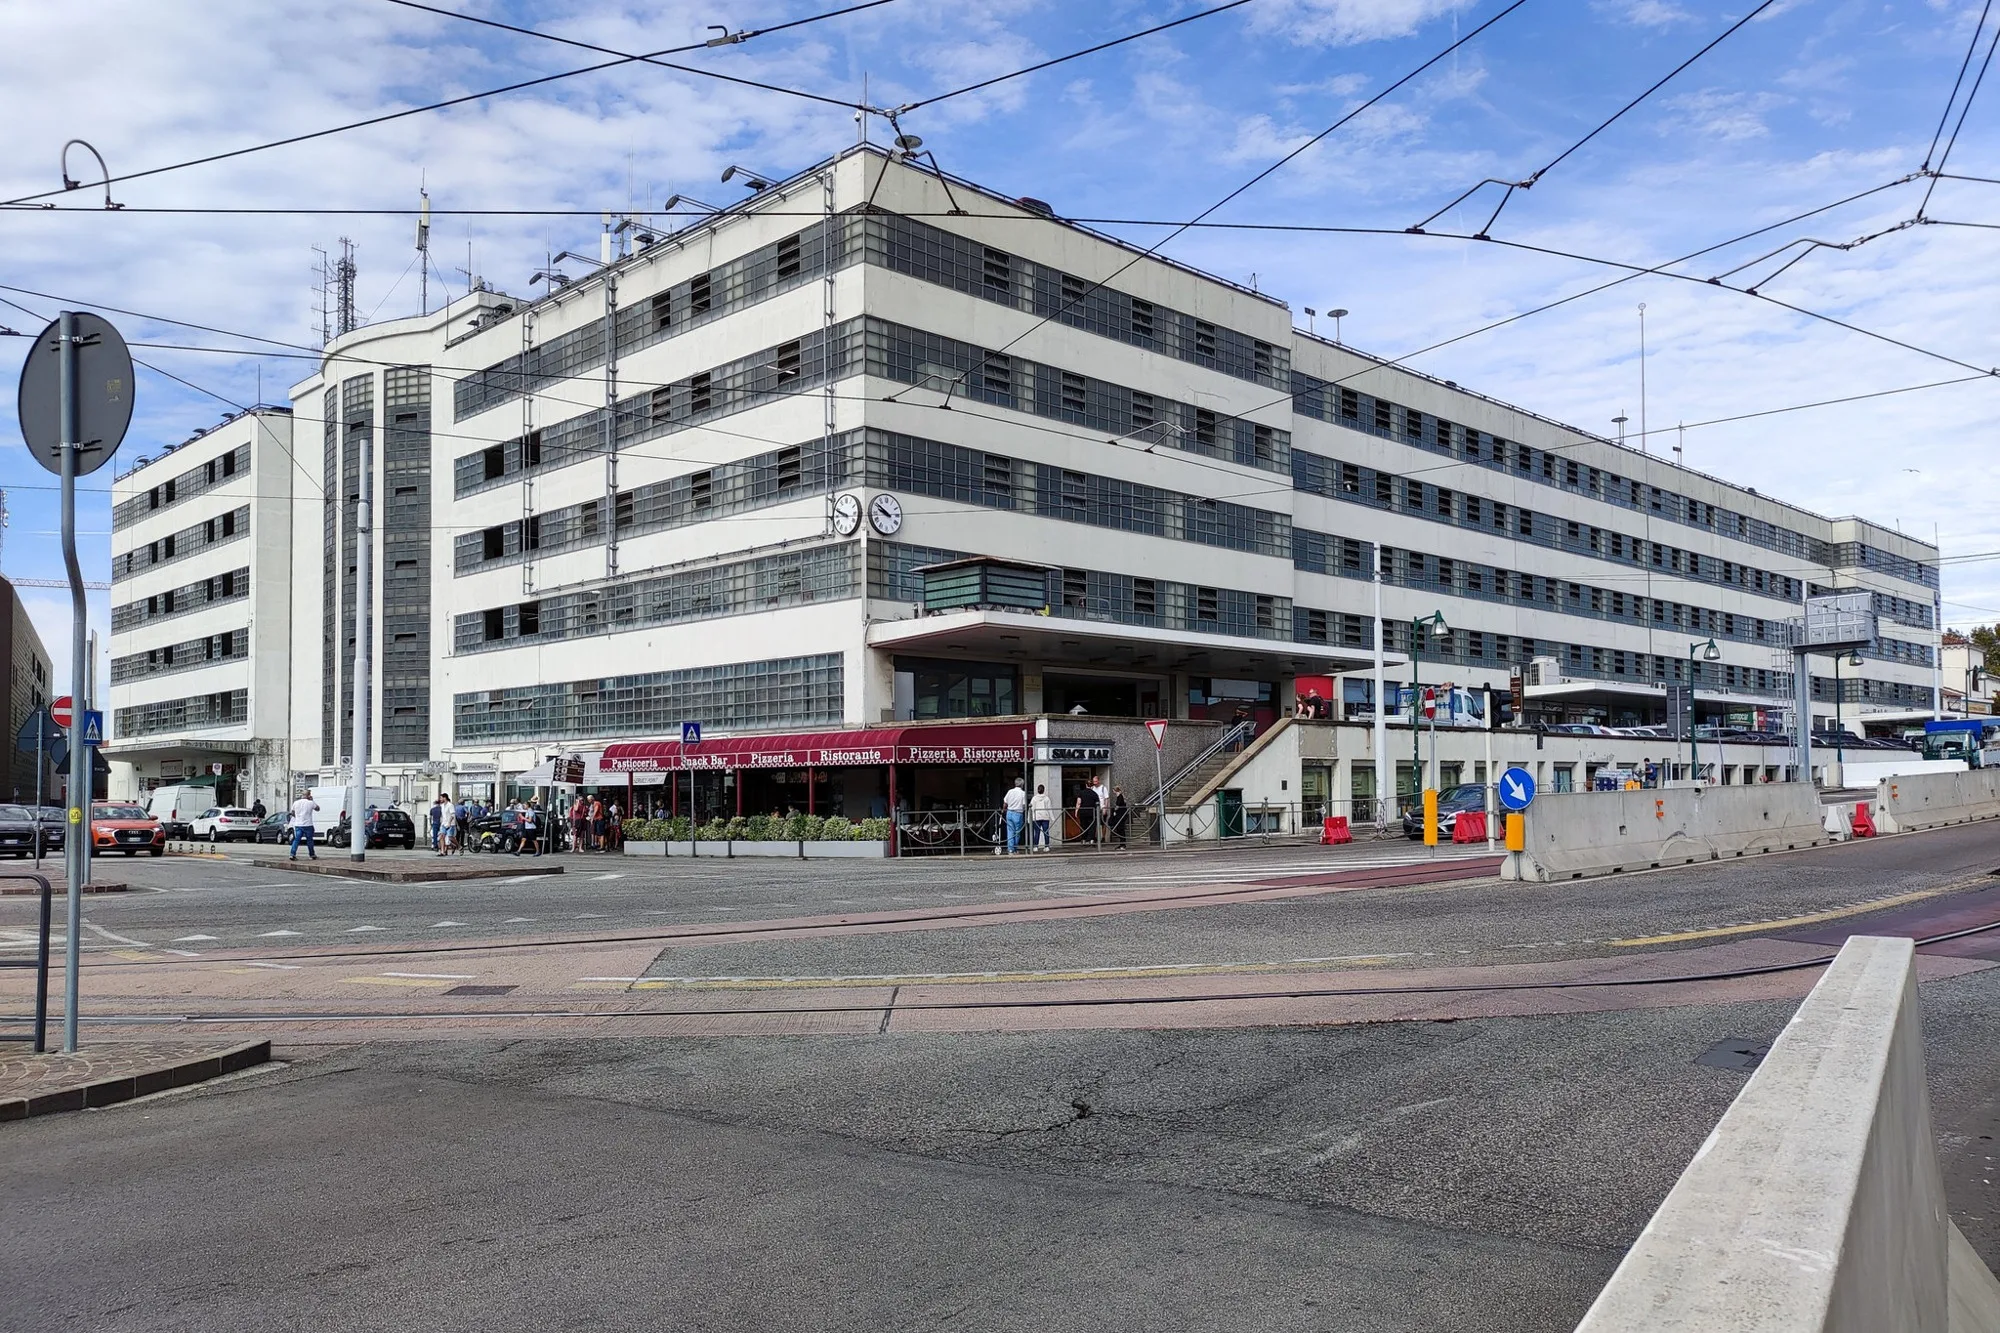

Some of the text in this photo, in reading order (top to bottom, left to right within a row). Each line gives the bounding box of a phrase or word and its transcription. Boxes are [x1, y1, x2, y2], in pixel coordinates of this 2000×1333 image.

[751, 753, 794, 764] Pizzeria
[820, 749, 880, 761] Ristorante
[910, 747, 1020, 759] Pizzeria Ristorante
[1051, 749, 1110, 759] SNACK BAR
[611, 759, 658, 768] Pasticceria
[681, 755, 728, 767] Snack Bar
